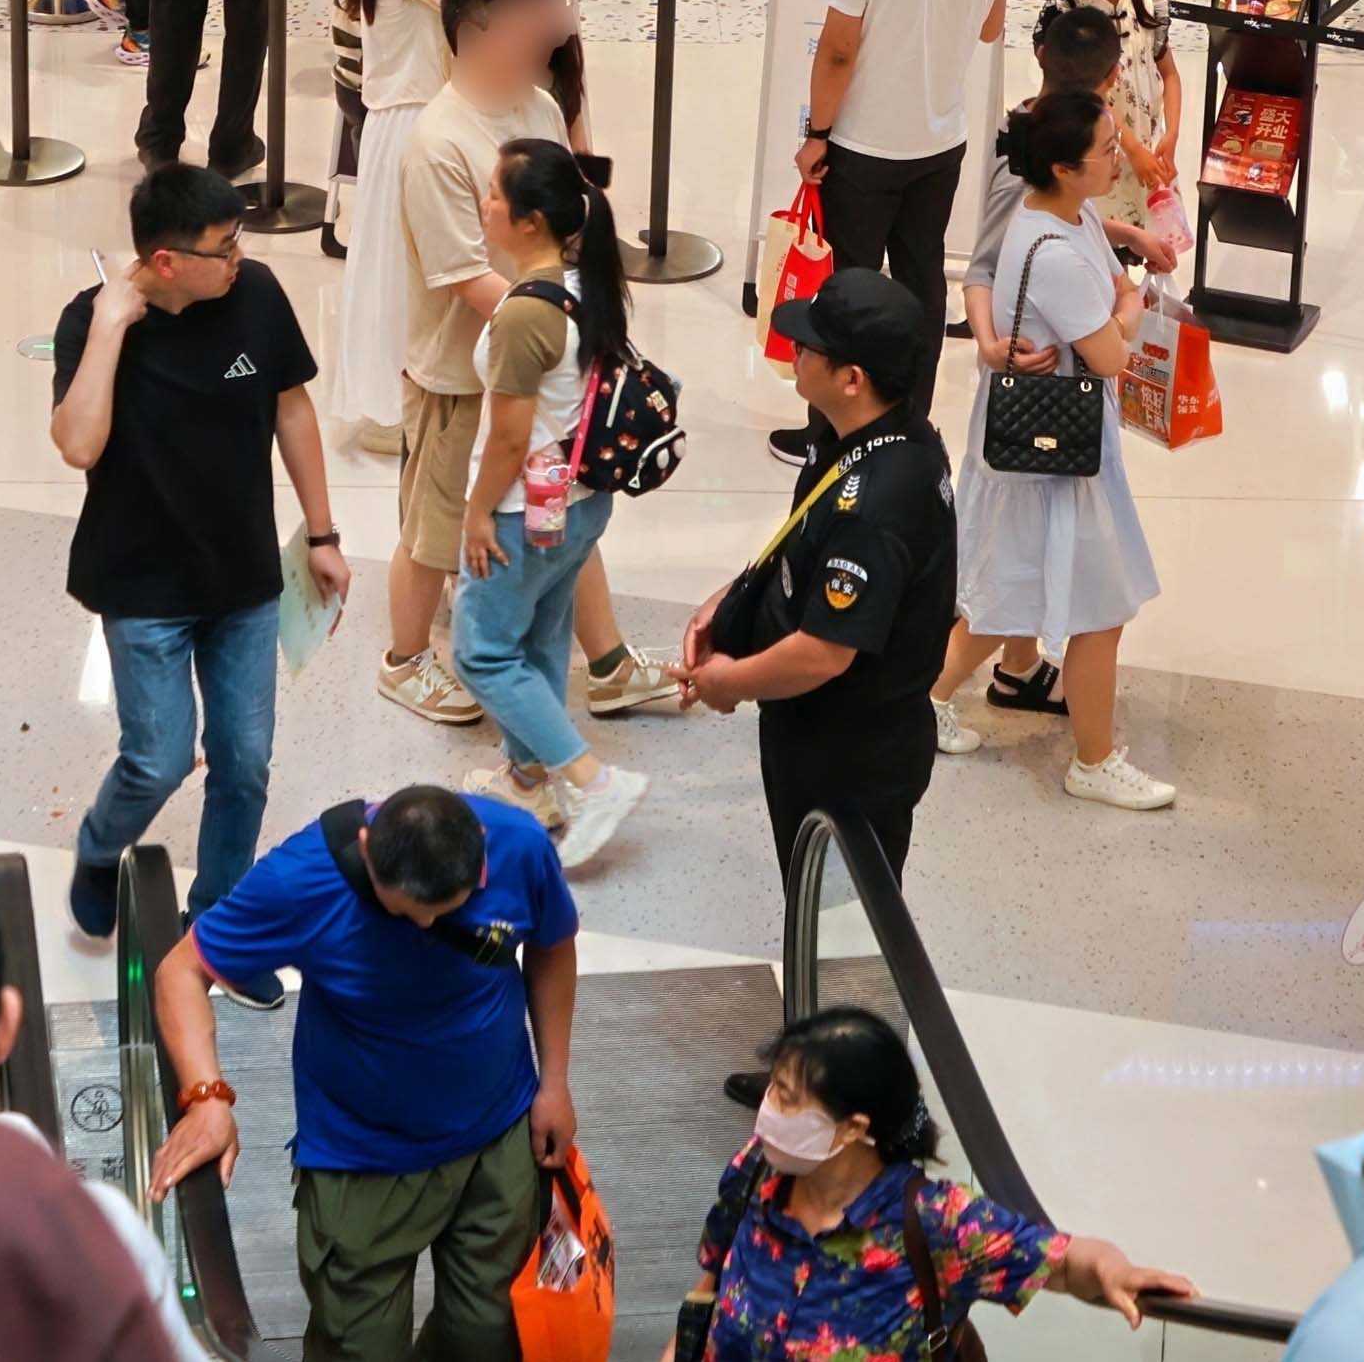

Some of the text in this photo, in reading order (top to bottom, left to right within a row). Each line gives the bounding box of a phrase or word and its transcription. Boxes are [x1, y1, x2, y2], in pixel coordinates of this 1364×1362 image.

[1259, 107, 1293, 126] 盛大
[1254, 122, 1289, 140] 开业
[830, 576, 855, 596] 保安
